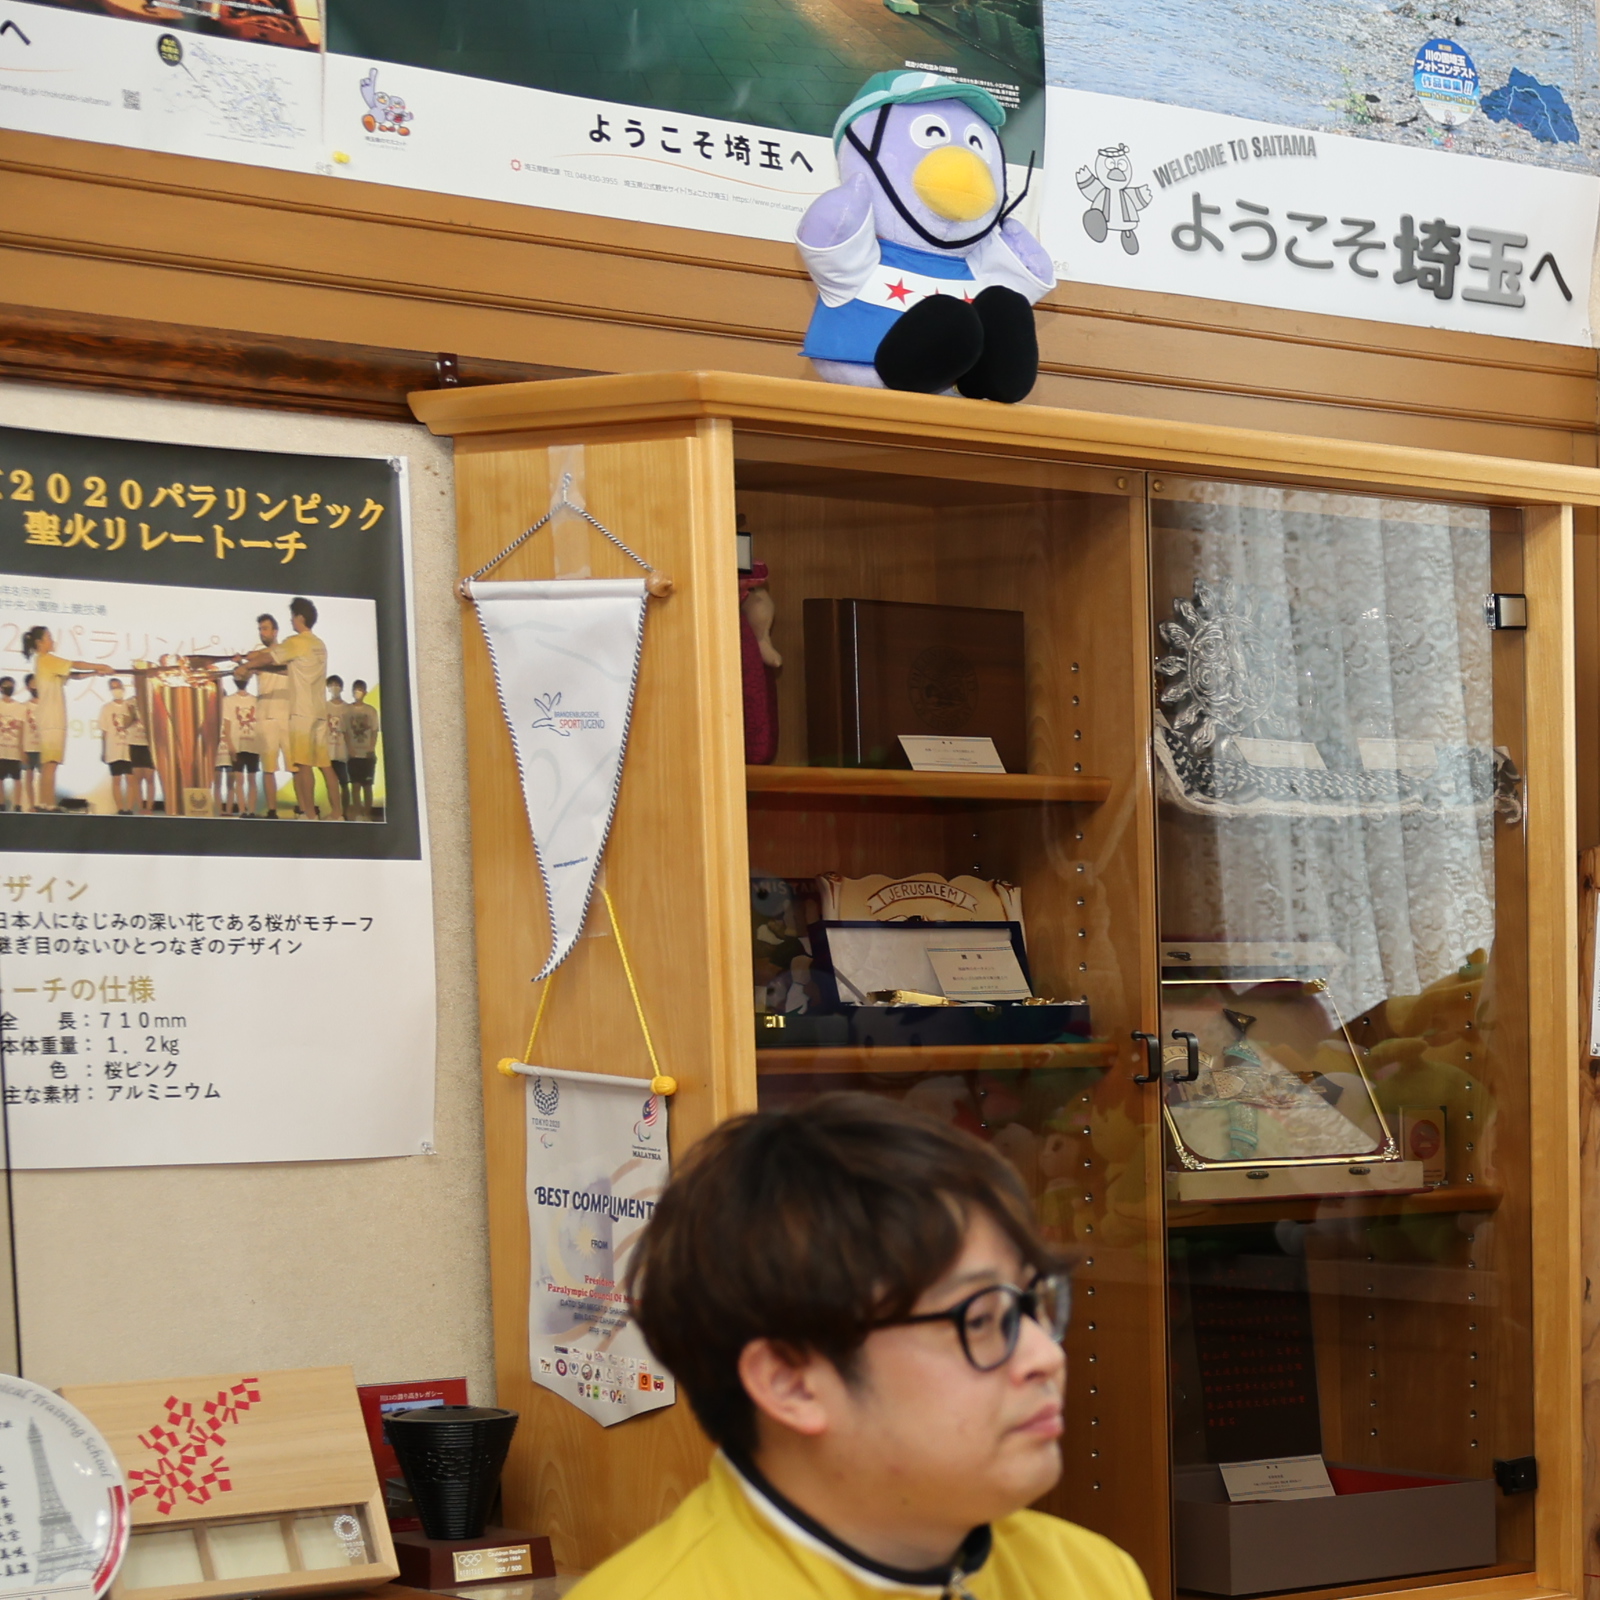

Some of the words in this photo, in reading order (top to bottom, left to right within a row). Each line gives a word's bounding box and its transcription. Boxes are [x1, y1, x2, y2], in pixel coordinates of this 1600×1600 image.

[1416, 60, 1476, 79] フォトコンテスト
[589, 114, 814, 173] ようこそ埼玉へ
[1153, 143, 1227, 189] WELCOME
[1228, 140, 1249, 162] TO
[1252, 135, 1318, 158] SAITAMA
[575, 172, 618, 185] 048-830-3955
[1170, 191, 1573, 309] ようこそ埼玉へ
[0, 468, 384, 531] 2020パラリンピック
[23, 510, 308, 564] 聖火リレートーチ
[559, 719, 605, 730] SPORTJUGEND
[0, 873, 89, 903] ザイン
[888, 881, 958, 900] JERUSALEM
[0, 911, 374, 932] 日本人になじみの深い花である桜がモチーフ
[0, 936, 303, 955] 継ぎ目のないひとつなぎのデザイン
[0, 975, 156, 1004] ーチの仕様
[632, 1150, 661, 1161] MALAYSIA
[534, 1186, 570, 1209] BEST
[572, 1191, 658, 1222] COMPLIMENT
[591, 1239, 609, 1250] FROM
[584, 1275, 615, 1288] President
[547, 1283, 588, 1298] Paralympic
[589, 1290, 613, 1302] Council
[32, 1393, 86, 1438] Training
[82, 1437, 115, 1479] School
